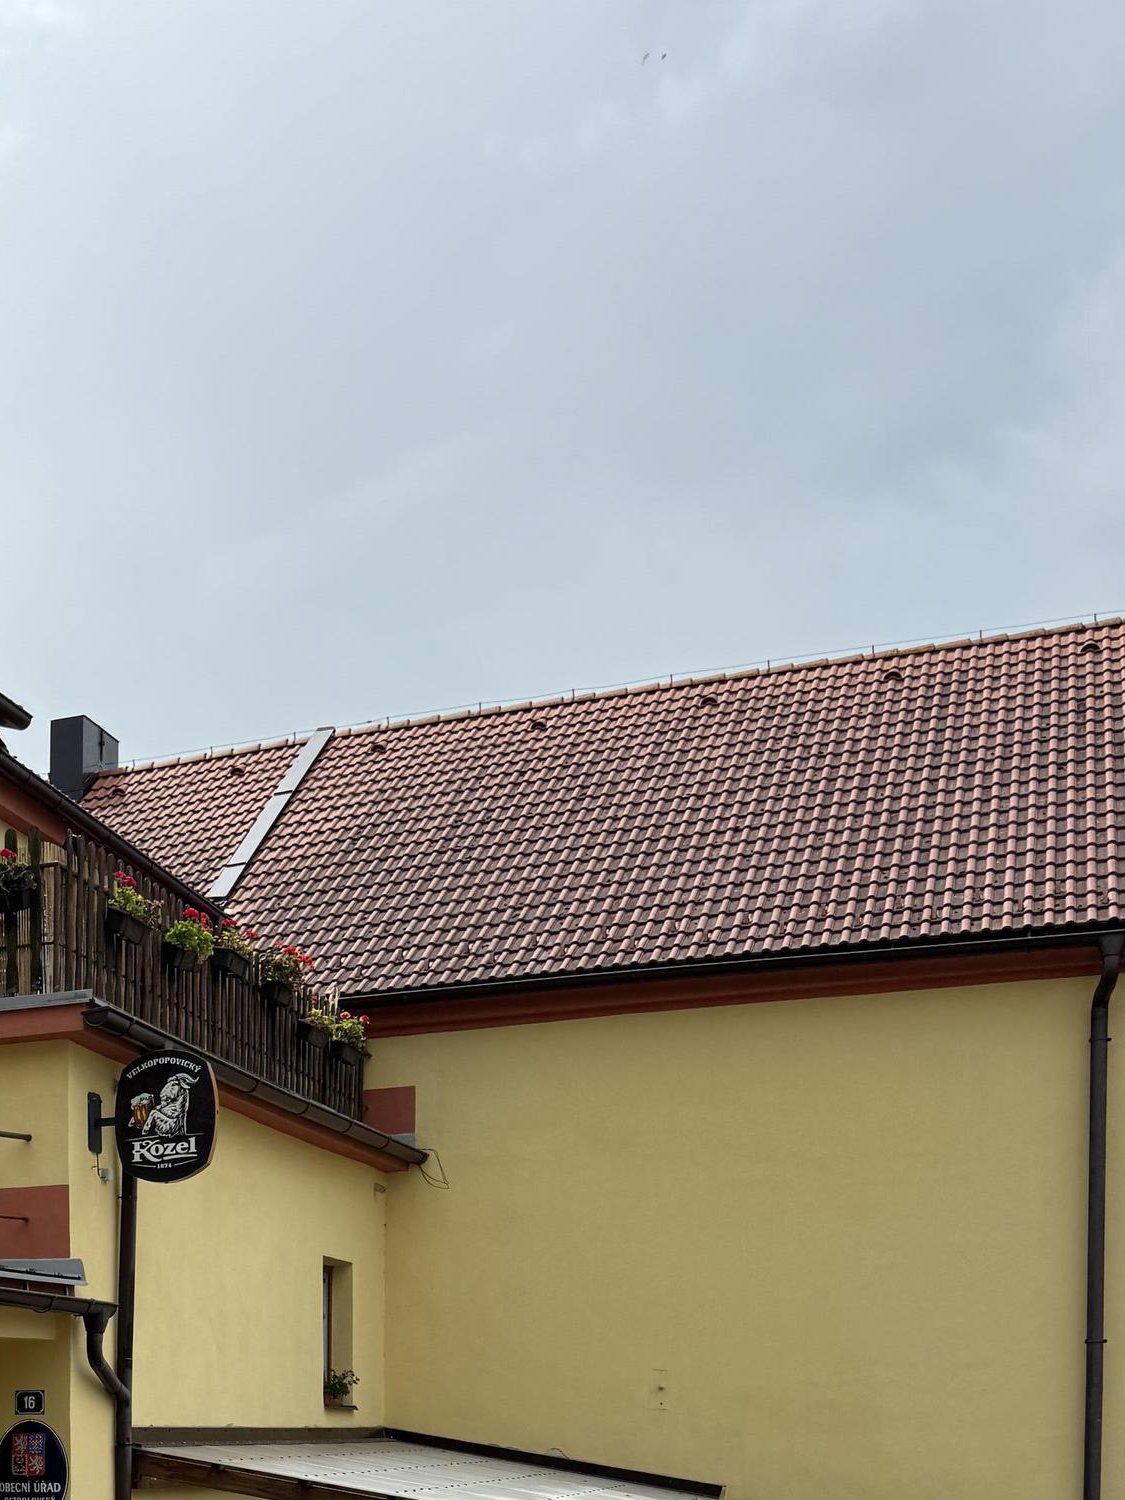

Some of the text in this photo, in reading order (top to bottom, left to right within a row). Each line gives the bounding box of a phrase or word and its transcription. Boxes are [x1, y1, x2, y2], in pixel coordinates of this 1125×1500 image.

[132, 1137, 197, 1162] Kozel
[23, 1395, 35, 1409] 16
[33, 1480, 62, 1493] ÚŘAD
